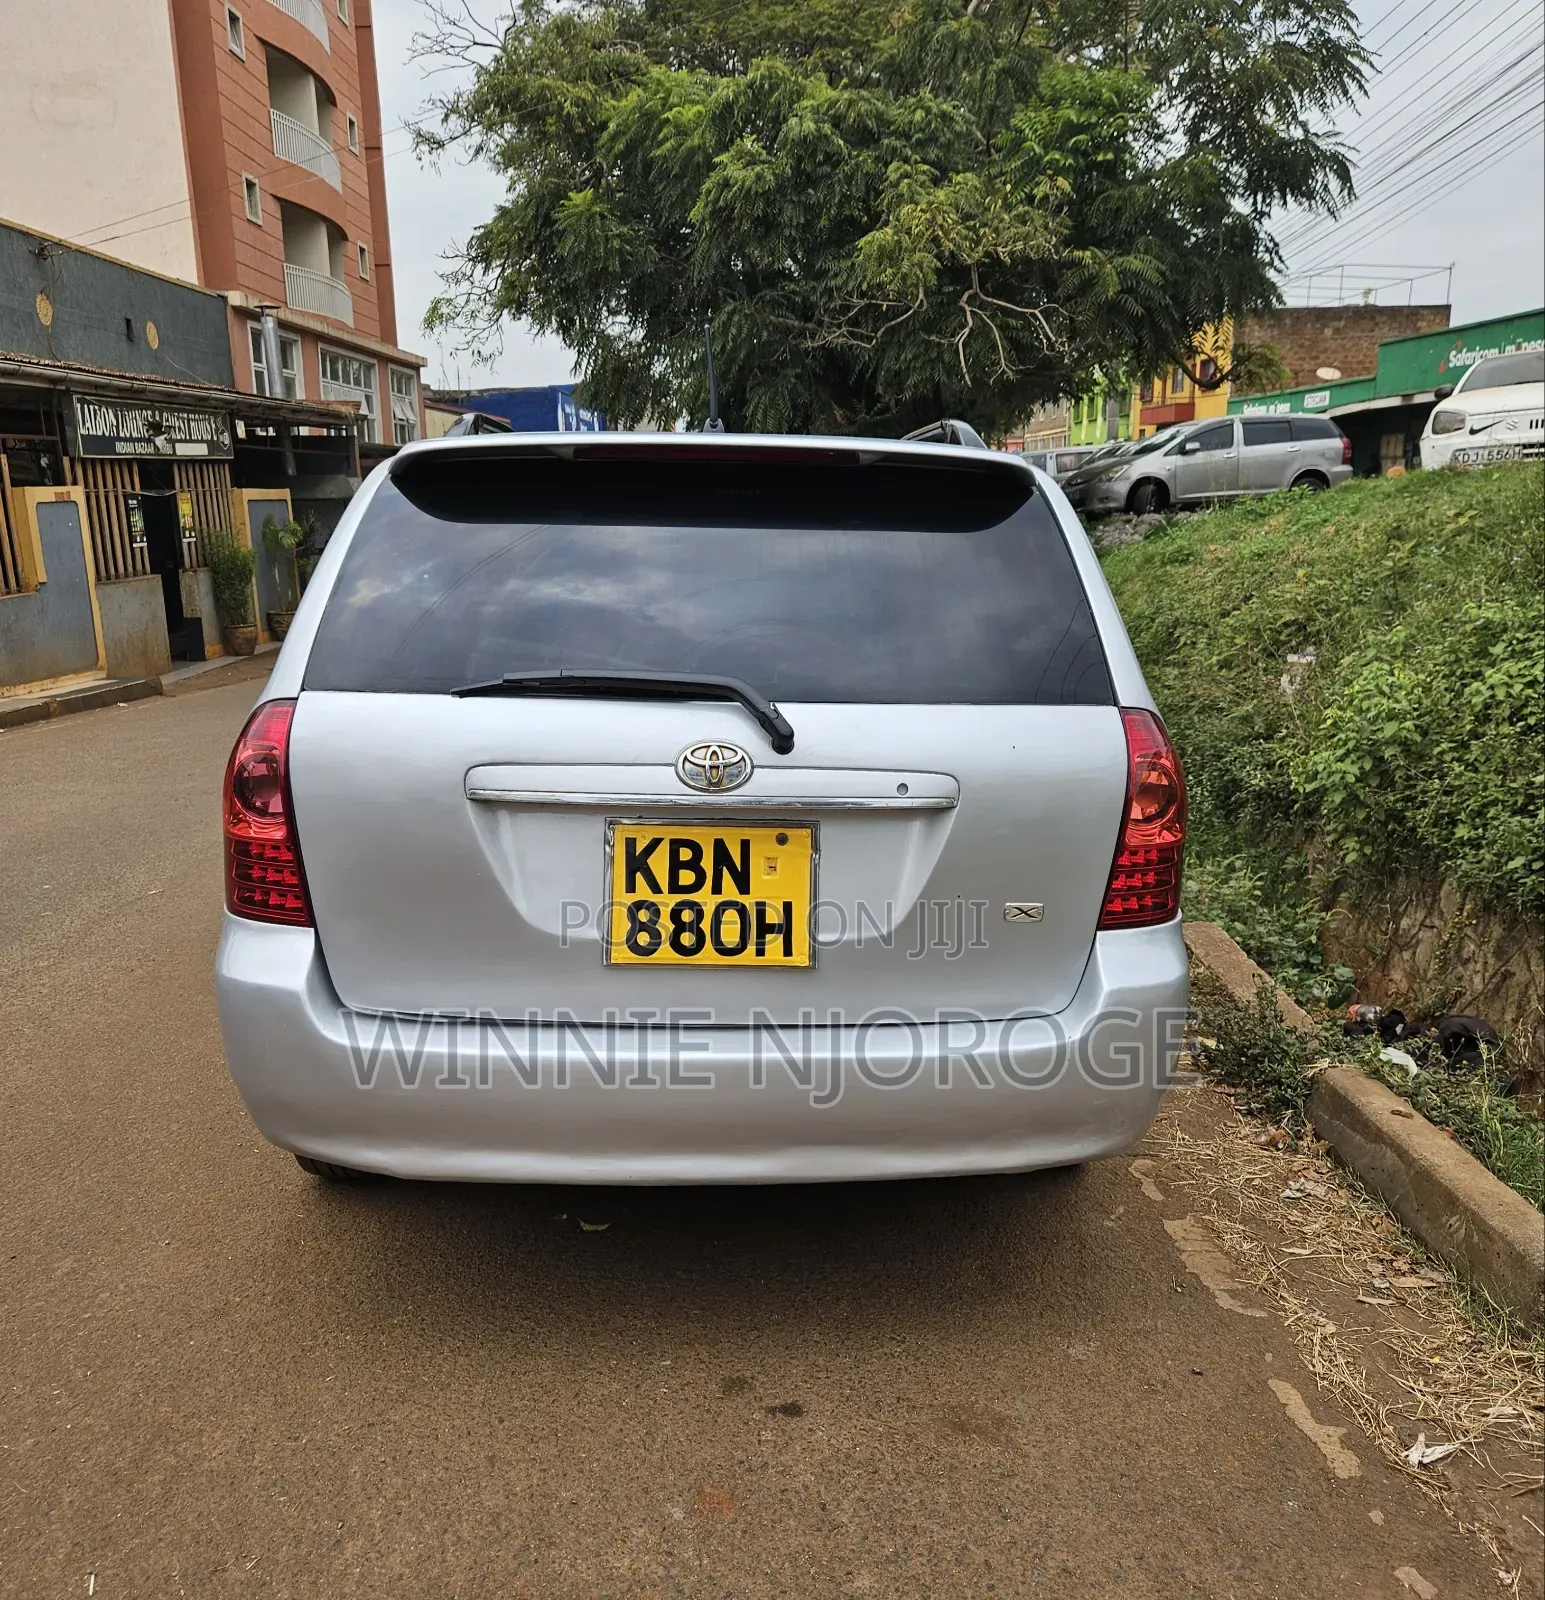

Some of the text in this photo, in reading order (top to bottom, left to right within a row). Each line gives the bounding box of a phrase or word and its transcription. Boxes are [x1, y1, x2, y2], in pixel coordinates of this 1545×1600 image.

[189, 413, 218, 440] HOUSE
[1454, 451, 1480, 464] KDJ
[624, 836, 751, 896] KBN
[625, 899, 794, 957] 880H
